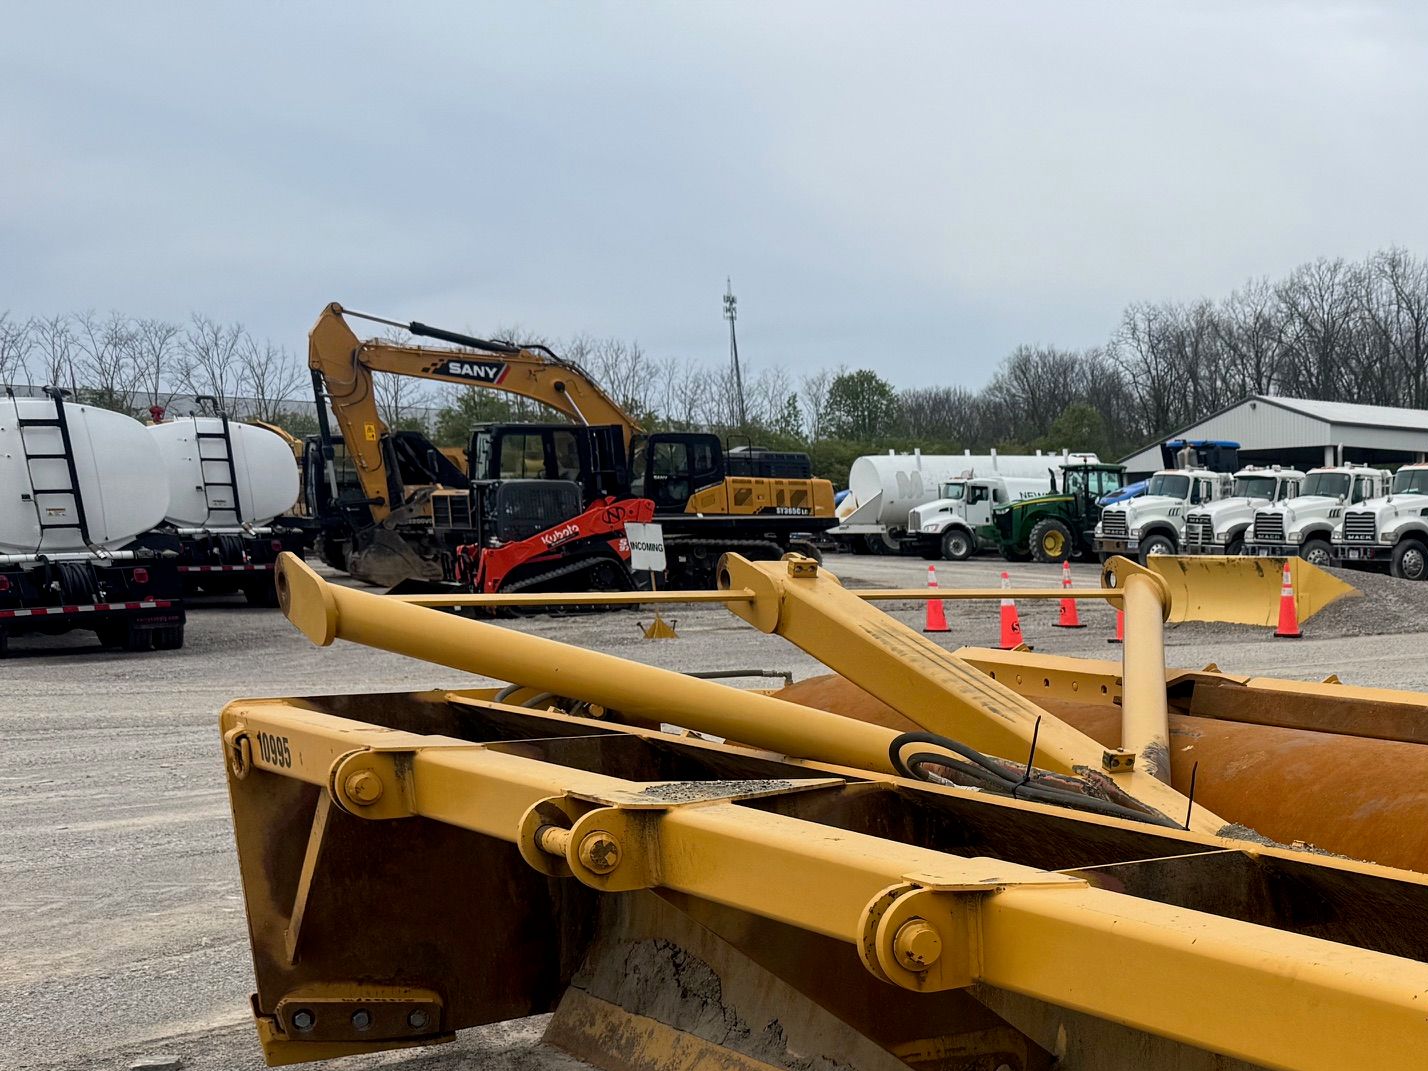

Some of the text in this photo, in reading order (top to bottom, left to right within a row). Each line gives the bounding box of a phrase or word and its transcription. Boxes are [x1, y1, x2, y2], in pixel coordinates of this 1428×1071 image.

[449, 362, 497, 379] SANY
[541, 525, 579, 544] Kubota
[630, 541, 663, 552] INCOMING
[257, 730, 291, 768] 10995
